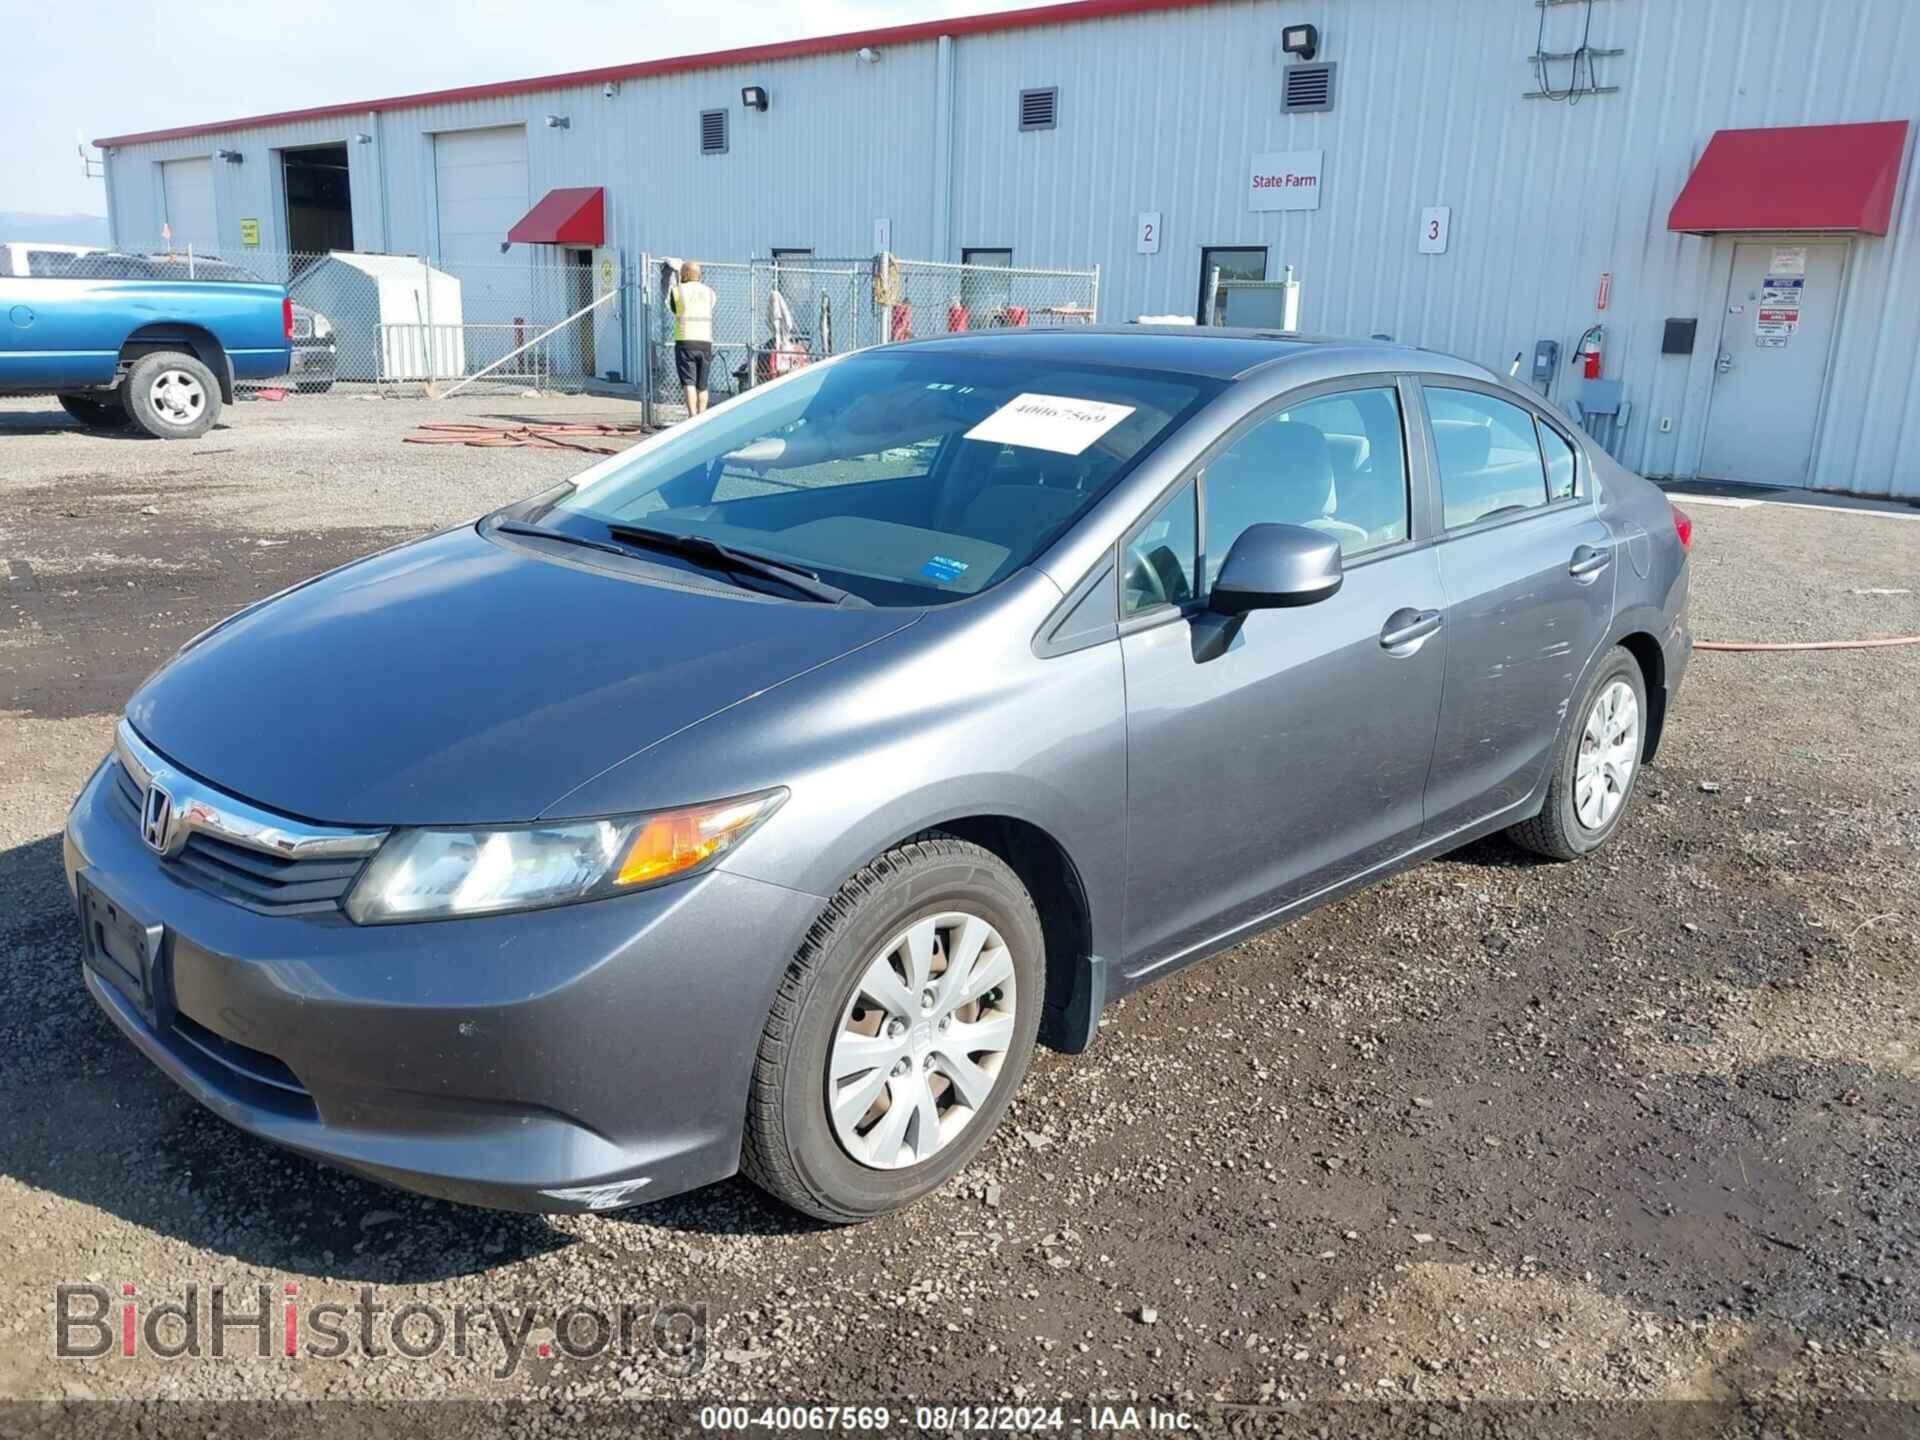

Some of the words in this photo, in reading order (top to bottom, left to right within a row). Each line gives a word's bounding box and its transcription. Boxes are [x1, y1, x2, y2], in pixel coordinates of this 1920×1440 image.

[1252, 175, 1283, 188] State
[1285, 174, 1317, 187] Farm
[1144, 224, 1153, 242] 2
[1428, 220, 1440, 240] 3
